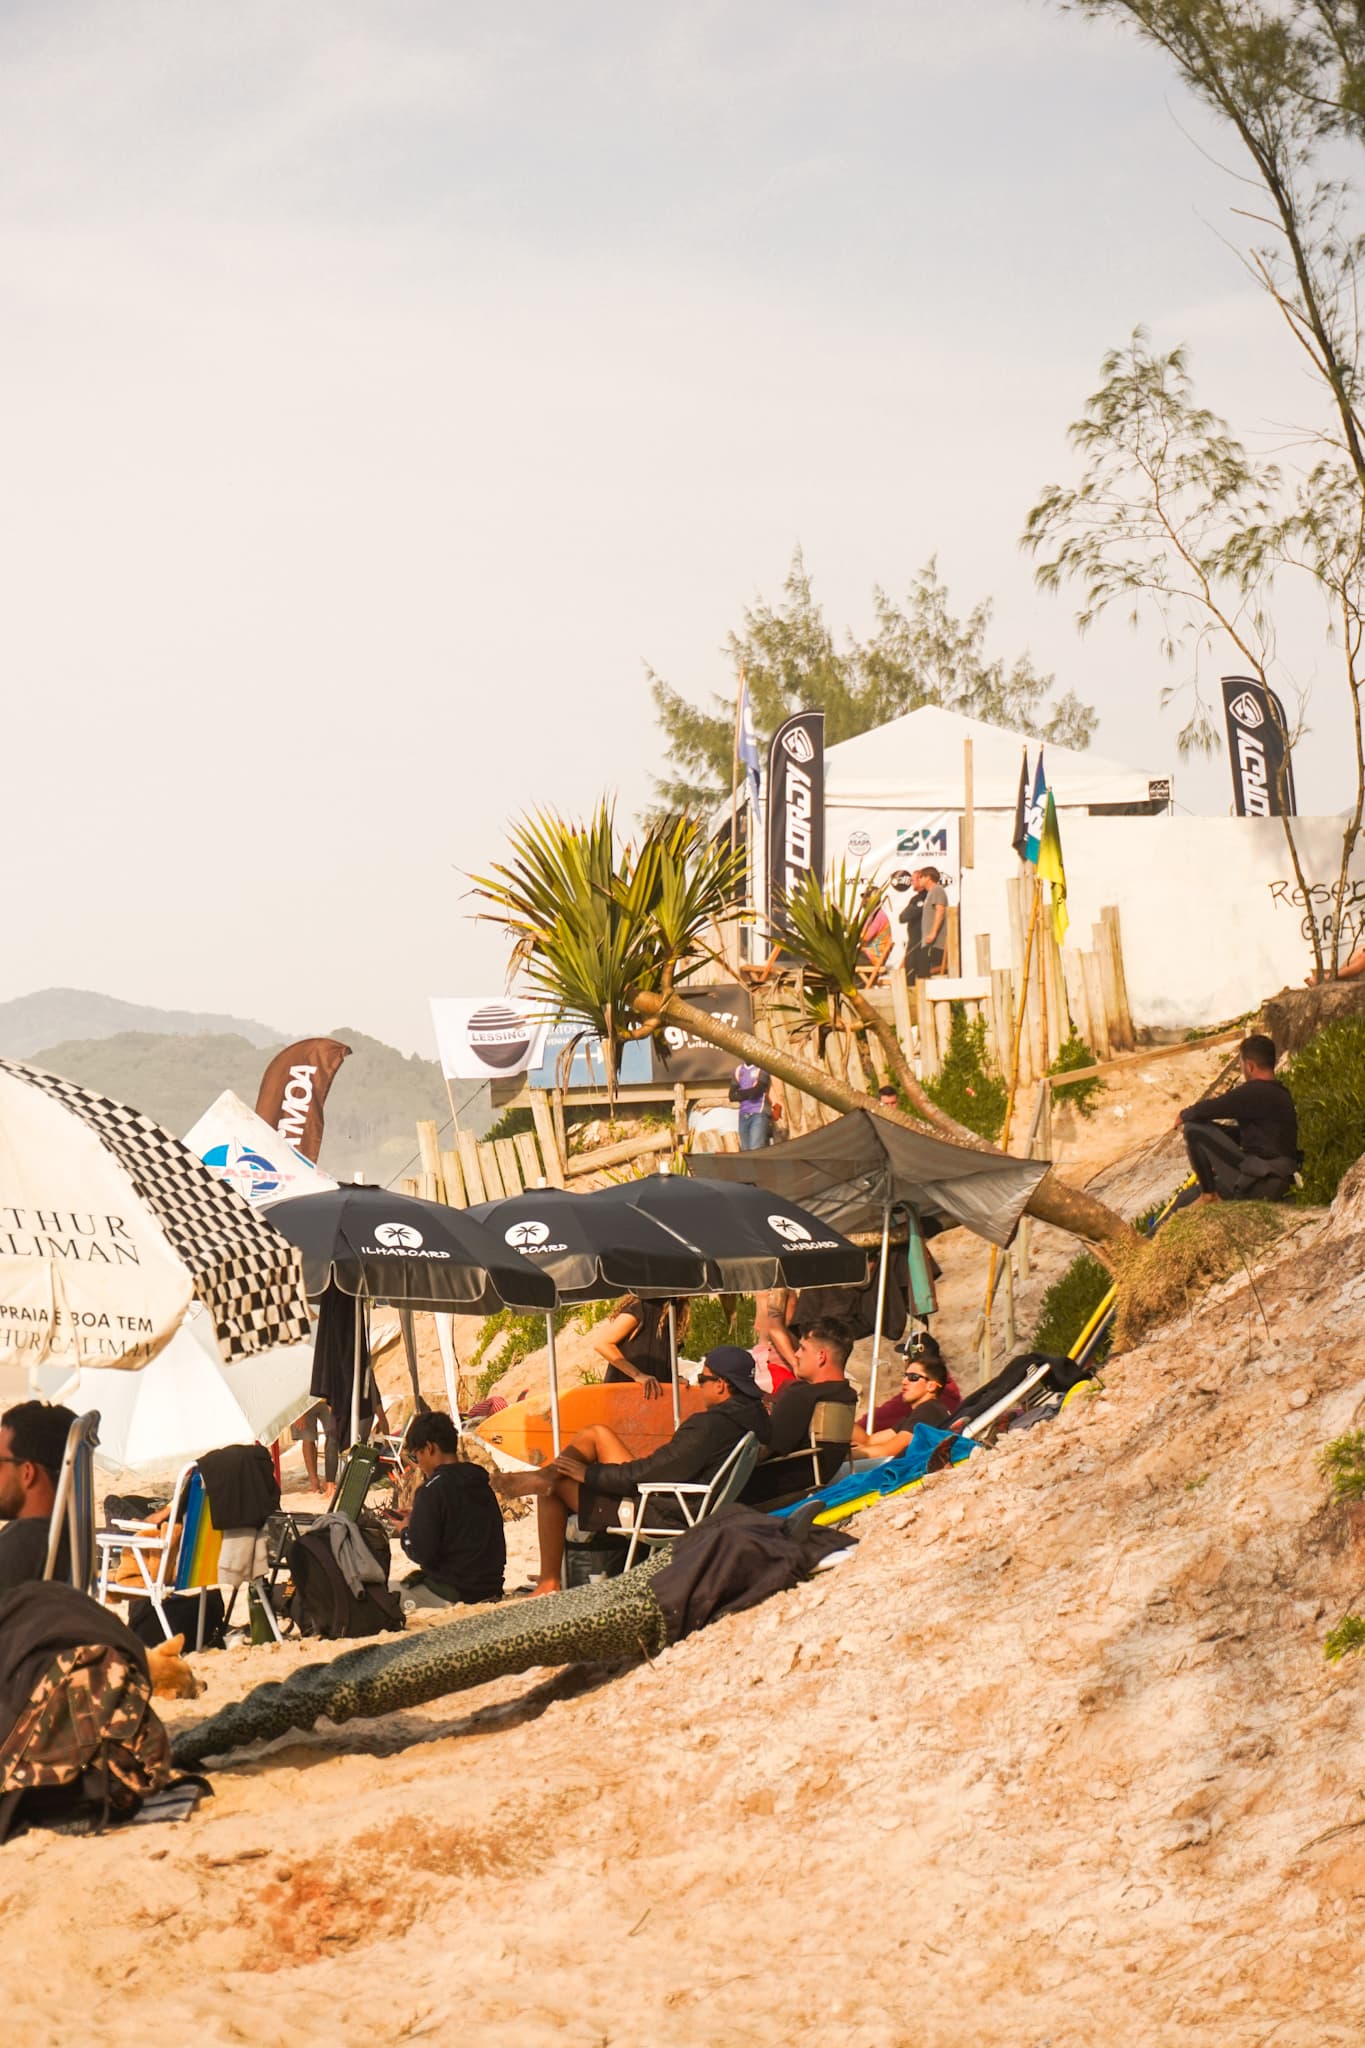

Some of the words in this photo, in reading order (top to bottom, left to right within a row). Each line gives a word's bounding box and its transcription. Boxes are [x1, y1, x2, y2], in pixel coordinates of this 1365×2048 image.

[471, 1030, 527, 1042] LESSING
[0, 1207, 133, 1240] THUR
[0, 1233, 142, 1267] LIMAN
[361, 1246, 451, 1259] ILHABOARD
[514, 1243, 569, 1256] BOARD
[0, 1305, 49, 1323] PRAIA
[71, 1312, 111, 1330] BOA
[117, 1315, 154, 1334] TEM
